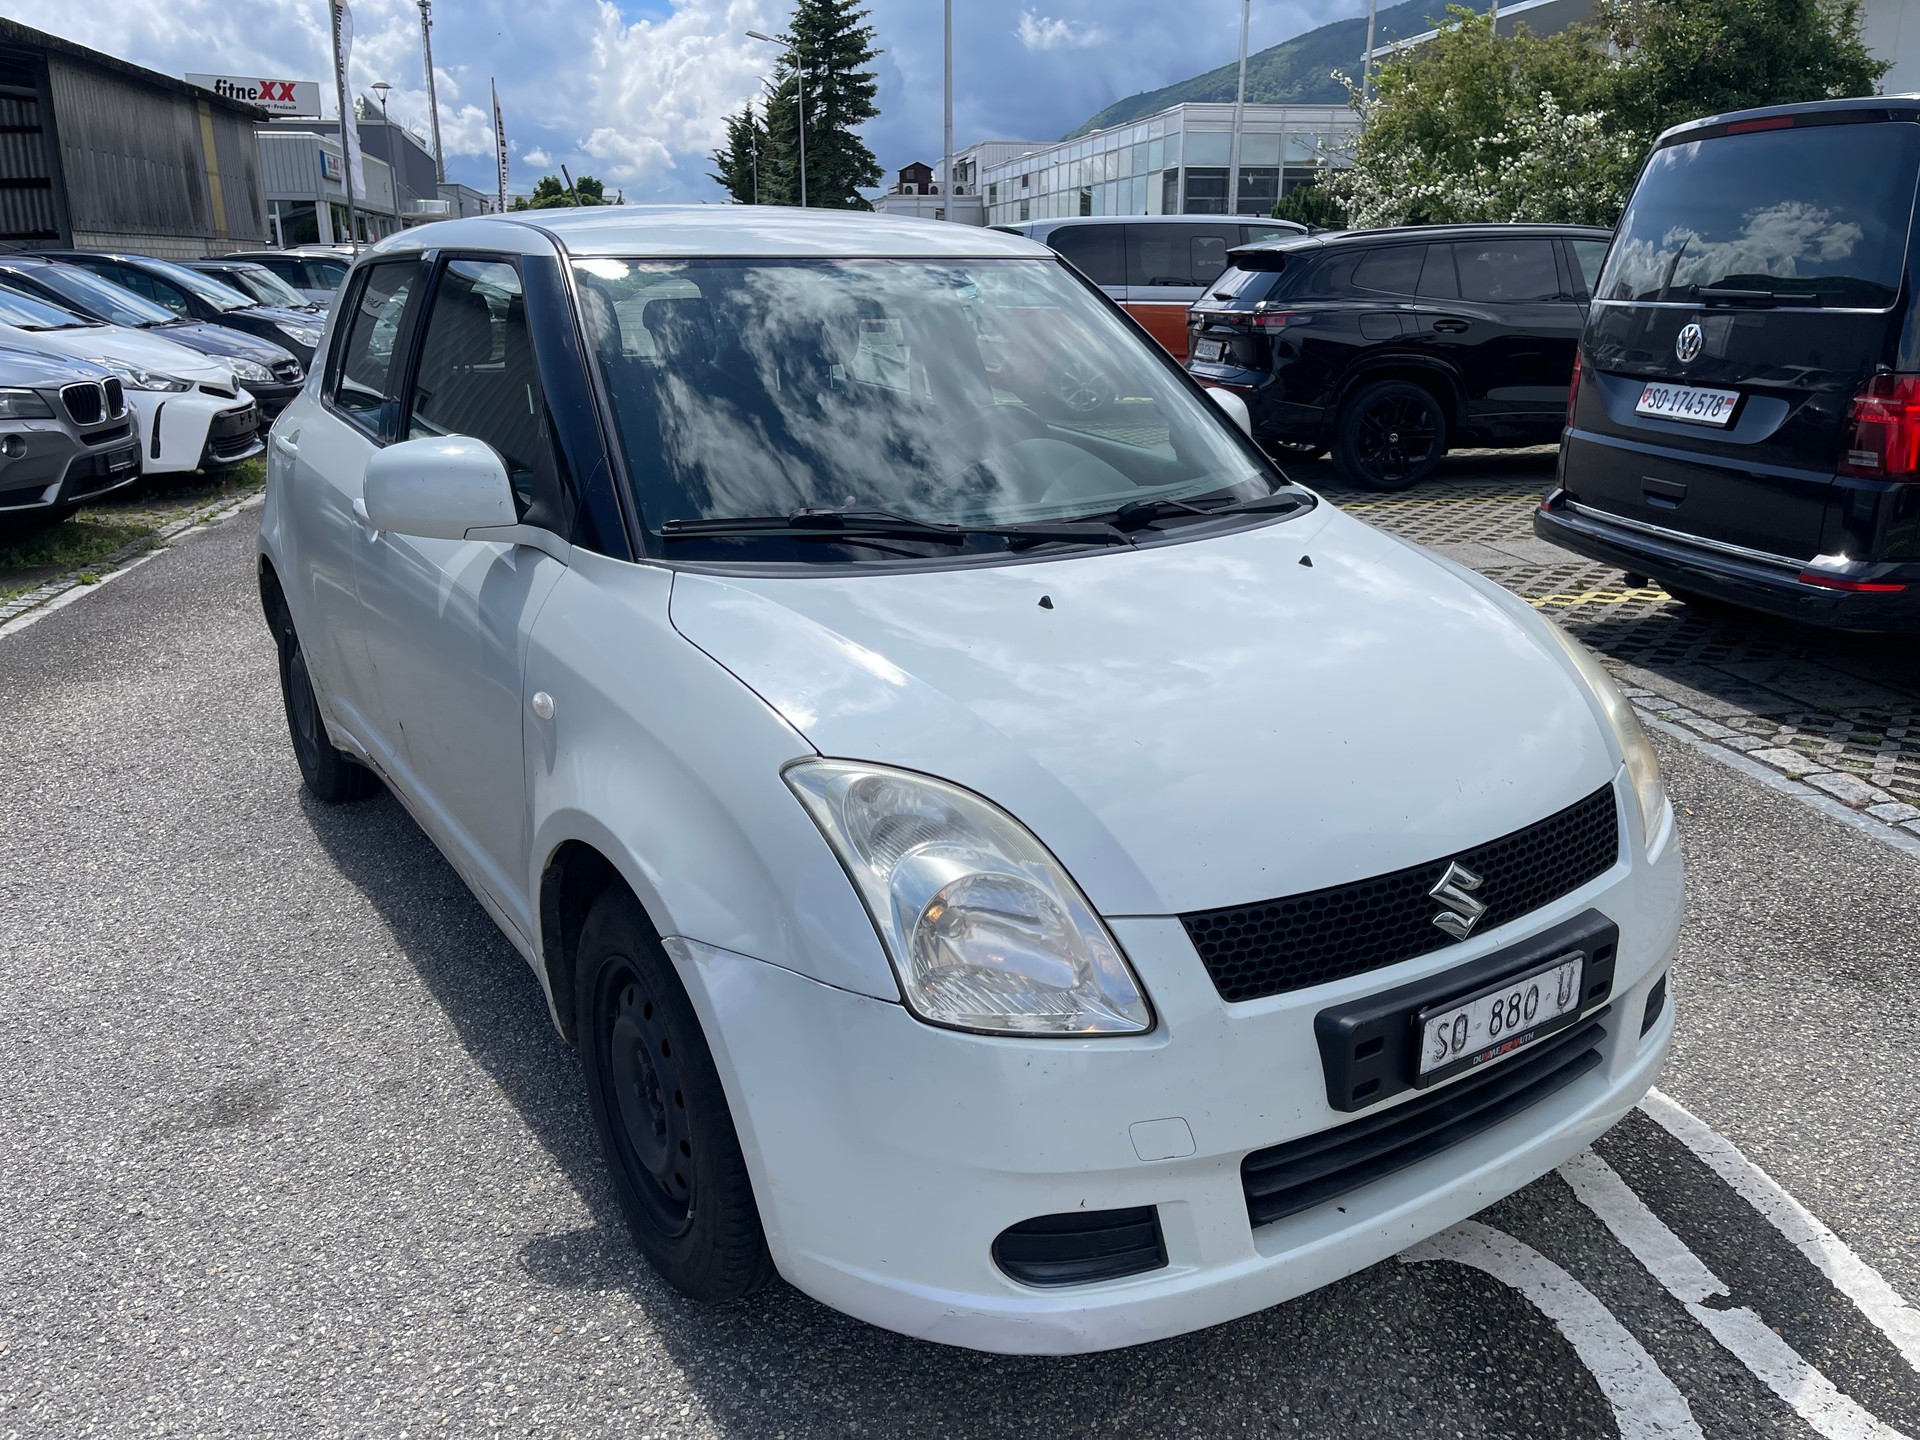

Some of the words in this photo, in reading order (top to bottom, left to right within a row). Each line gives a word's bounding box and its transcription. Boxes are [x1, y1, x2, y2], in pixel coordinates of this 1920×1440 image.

[213, 78, 297, 102] fitneXX
[1432, 1012, 1469, 1062] SO
[1488, 983, 1540, 1037] 880
[1556, 961, 1575, 1008] U
